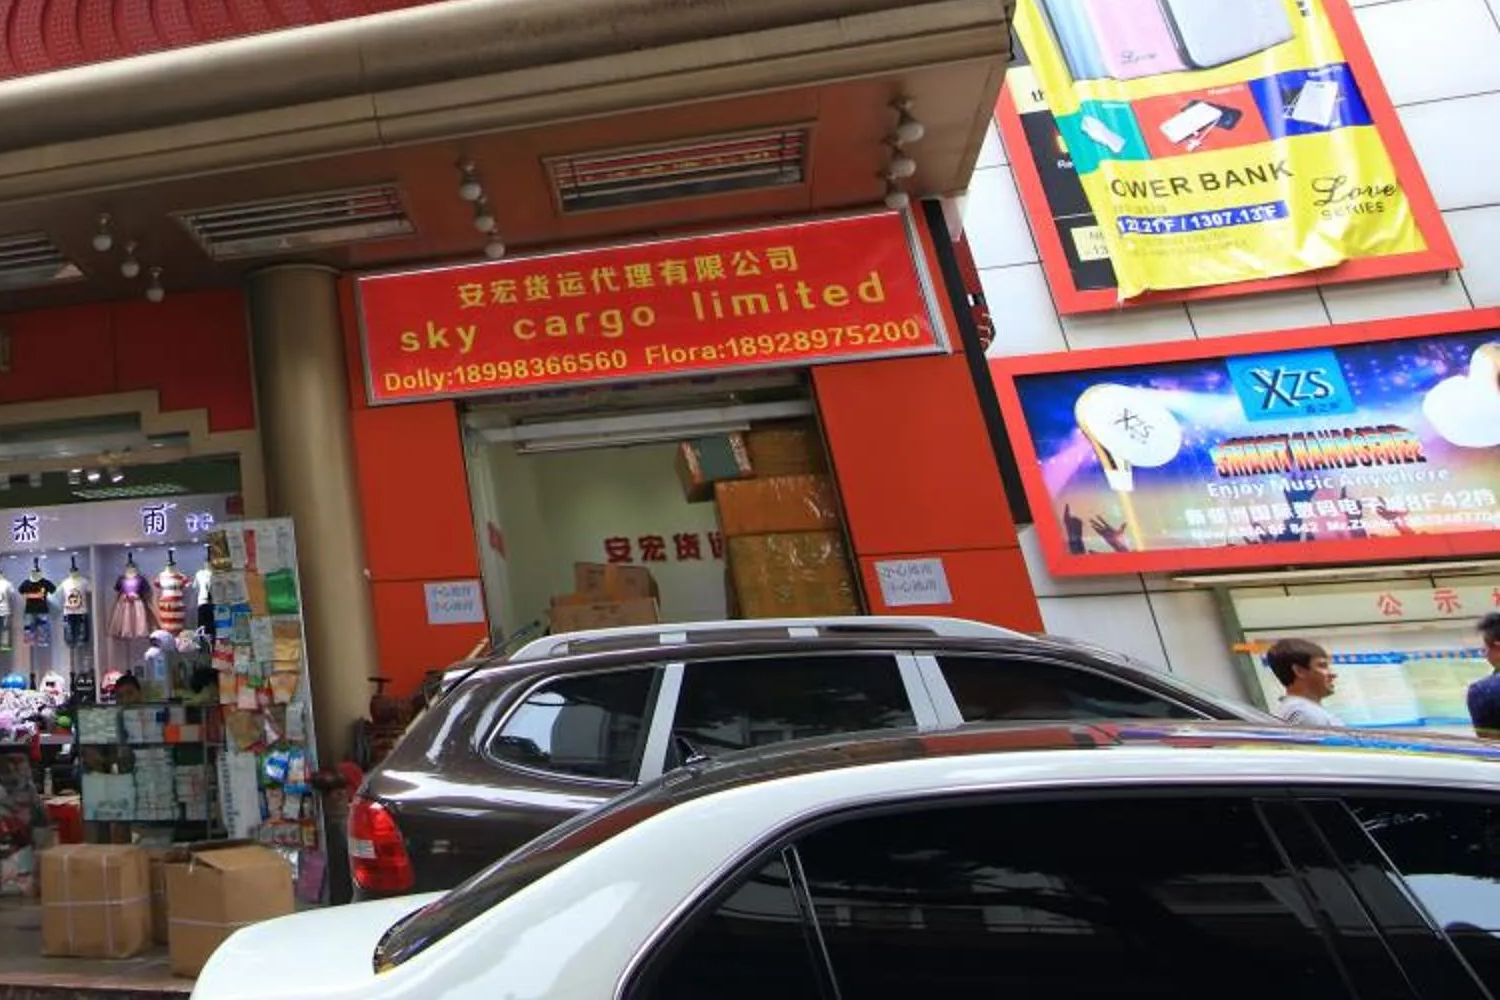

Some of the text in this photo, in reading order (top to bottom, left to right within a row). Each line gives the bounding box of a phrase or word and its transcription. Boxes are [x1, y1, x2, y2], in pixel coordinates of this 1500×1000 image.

[1199, 159, 1294, 192] BANK
[1311, 174, 1397, 207] Love
[458, 245, 799, 309] 安宏货运代理有限公司
[400, 271, 886, 354] sky cargo limited
[384, 318, 921, 393] Dolly:18998366560 Flora:18928975200
[1251, 365, 1335, 411] XZS
[1207, 480, 1264, 500] Enjoy
[1270, 470, 1334, 492] Music
